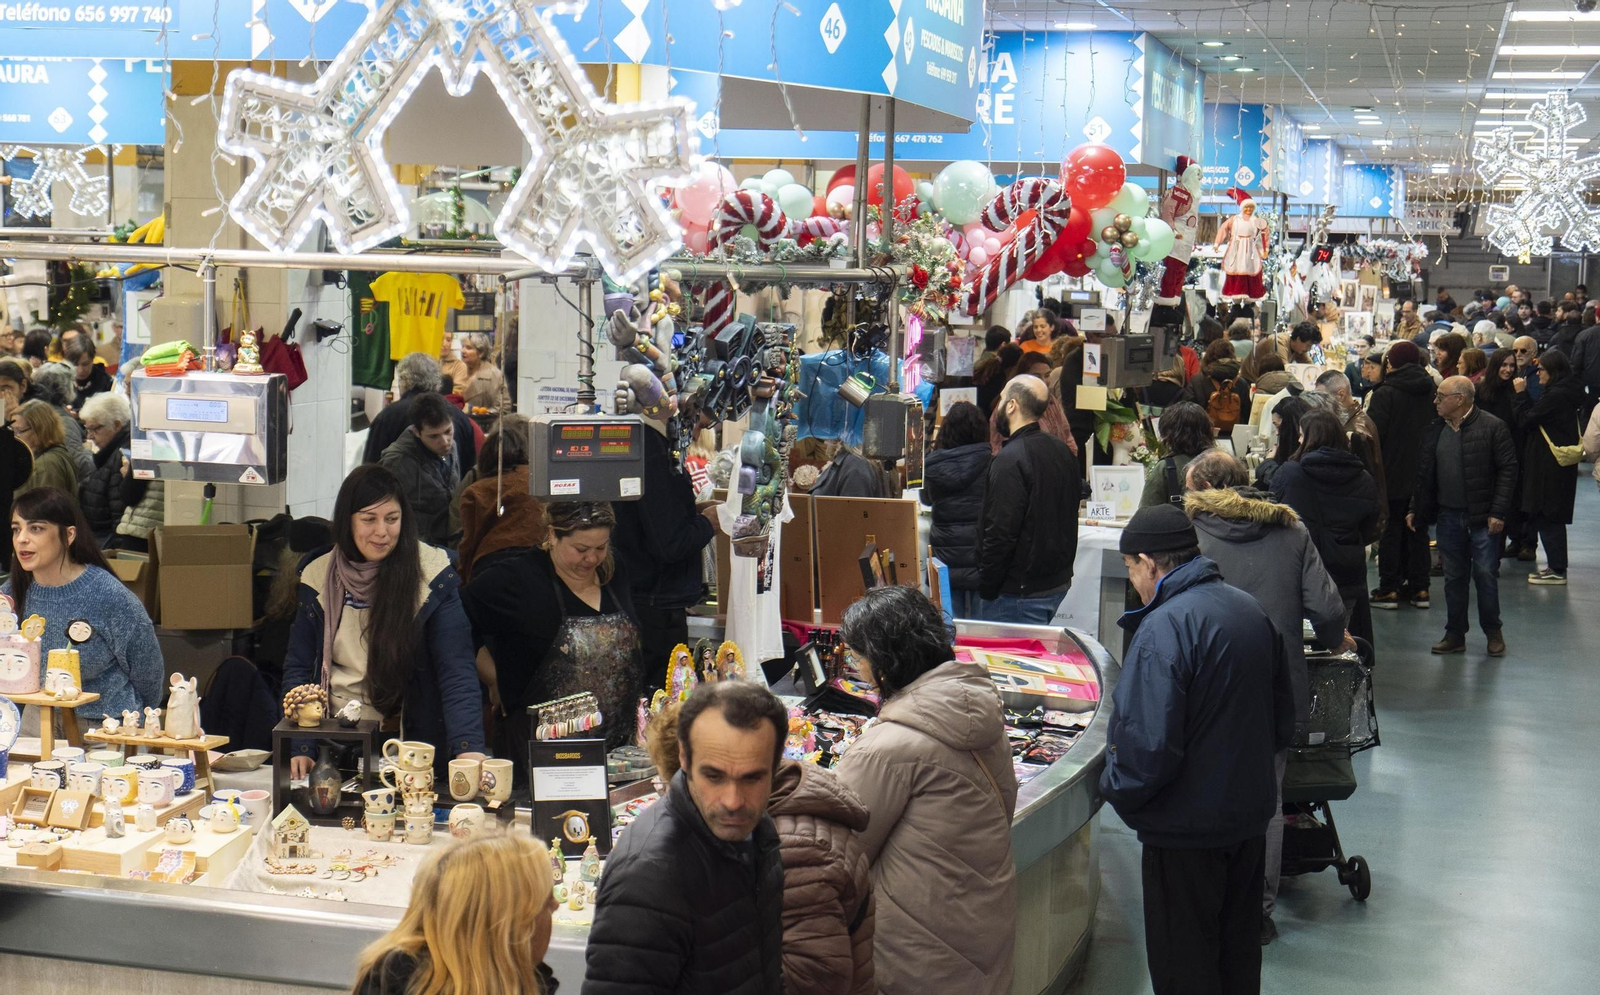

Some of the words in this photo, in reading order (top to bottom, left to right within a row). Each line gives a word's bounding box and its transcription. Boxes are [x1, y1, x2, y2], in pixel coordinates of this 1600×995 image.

[0, 3, 70, 22] Teléfono
[74, 5, 105, 22] 656
[109, 6, 139, 23] 997
[142, 6, 172, 23] 740
[824, 18, 841, 40] 46
[1088, 123, 1104, 136] 51
[895, 134, 910, 143] 667
[911, 134, 927, 143] 478
[928, 134, 943, 143] 762
[1213, 176, 1229, 185] 247
[1238, 171, 1251, 180] 66
[1317, 250, 1330, 261] 74
[1090, 506, 1110, 516] ARTE
